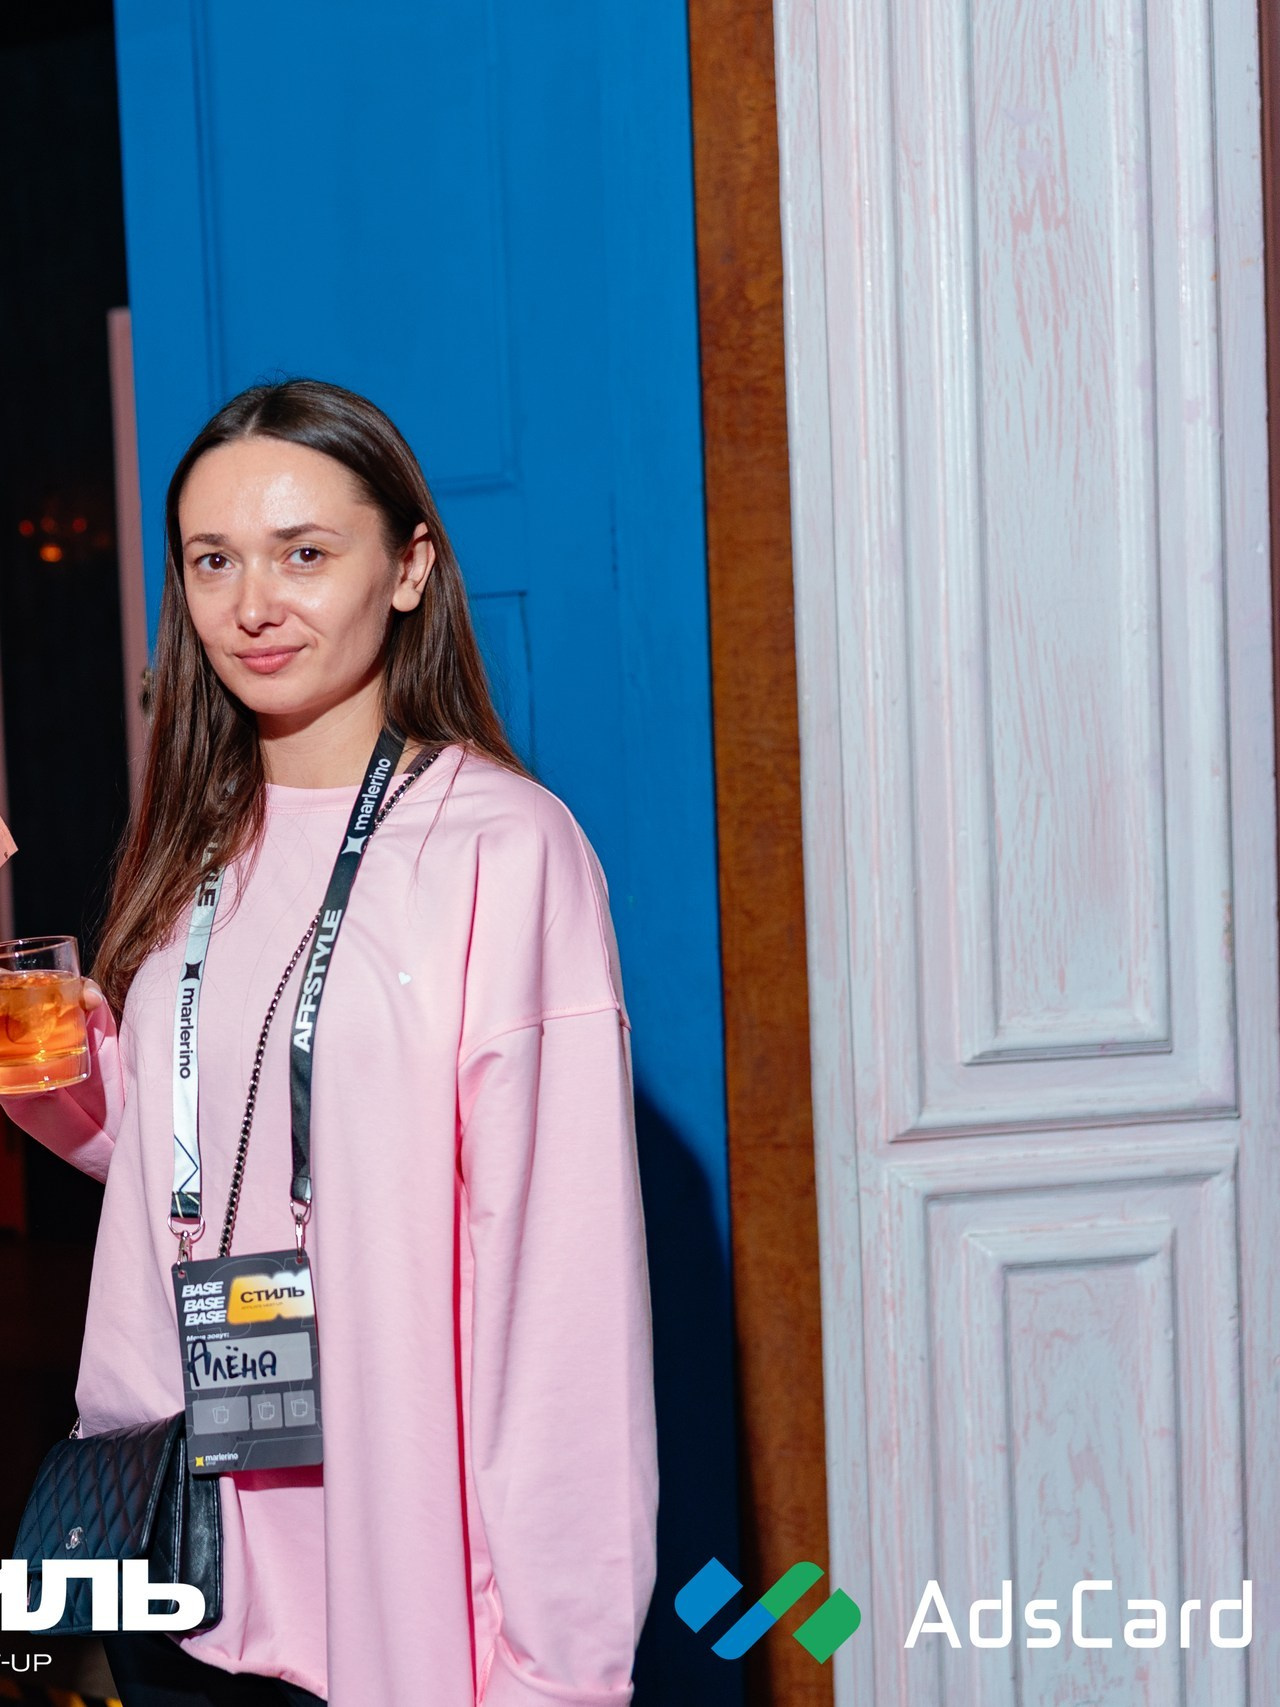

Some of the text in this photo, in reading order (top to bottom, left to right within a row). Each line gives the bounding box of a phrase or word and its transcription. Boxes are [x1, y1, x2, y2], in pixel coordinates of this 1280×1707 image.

[353, 756, 392, 831] marlerino
[292, 908, 343, 1053] AFFSTYLE
[179, 987, 197, 1080] marlerino
[181, 1281, 224, 1298] BASE
[240, 1286, 305, 1303] СТИЛЬ
[183, 1296, 226, 1313] BASE
[185, 1310, 227, 1327] BASE
